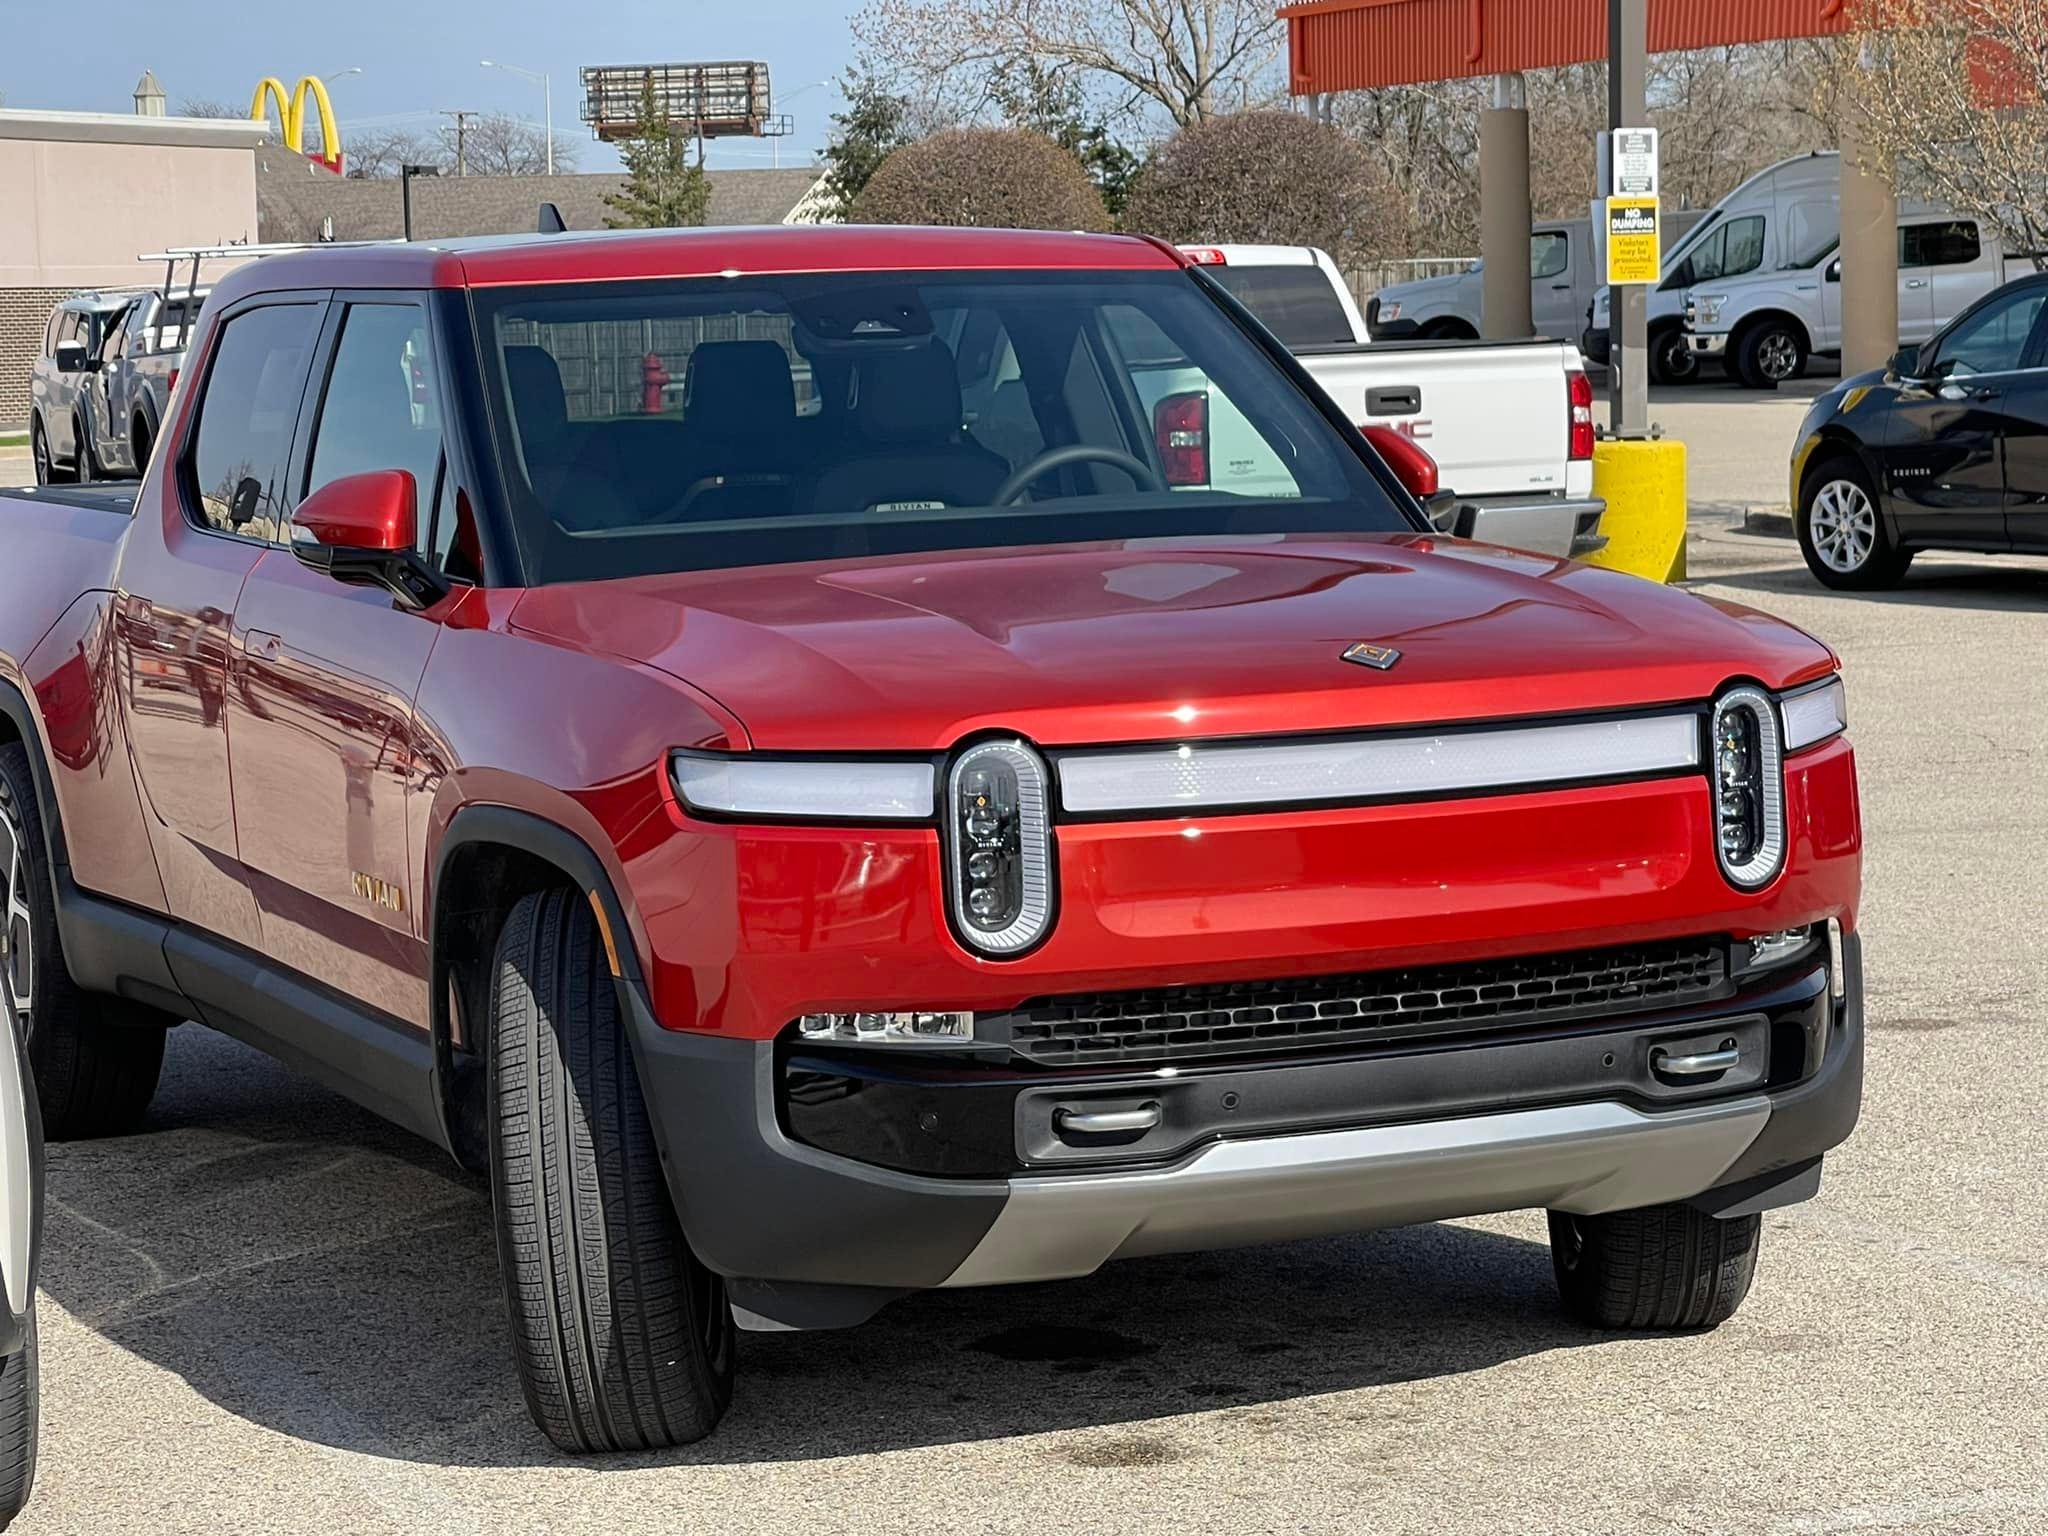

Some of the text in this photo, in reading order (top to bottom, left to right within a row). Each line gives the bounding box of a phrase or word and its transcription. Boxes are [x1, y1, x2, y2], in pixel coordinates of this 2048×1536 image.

[1625, 207, 1641, 218] NO
[1611, 217, 1654, 229] DUMPING
[1618, 238, 1649, 246] Violators
[1620, 248, 1635, 256] may
[351, 871, 401, 912] RIVIAN
